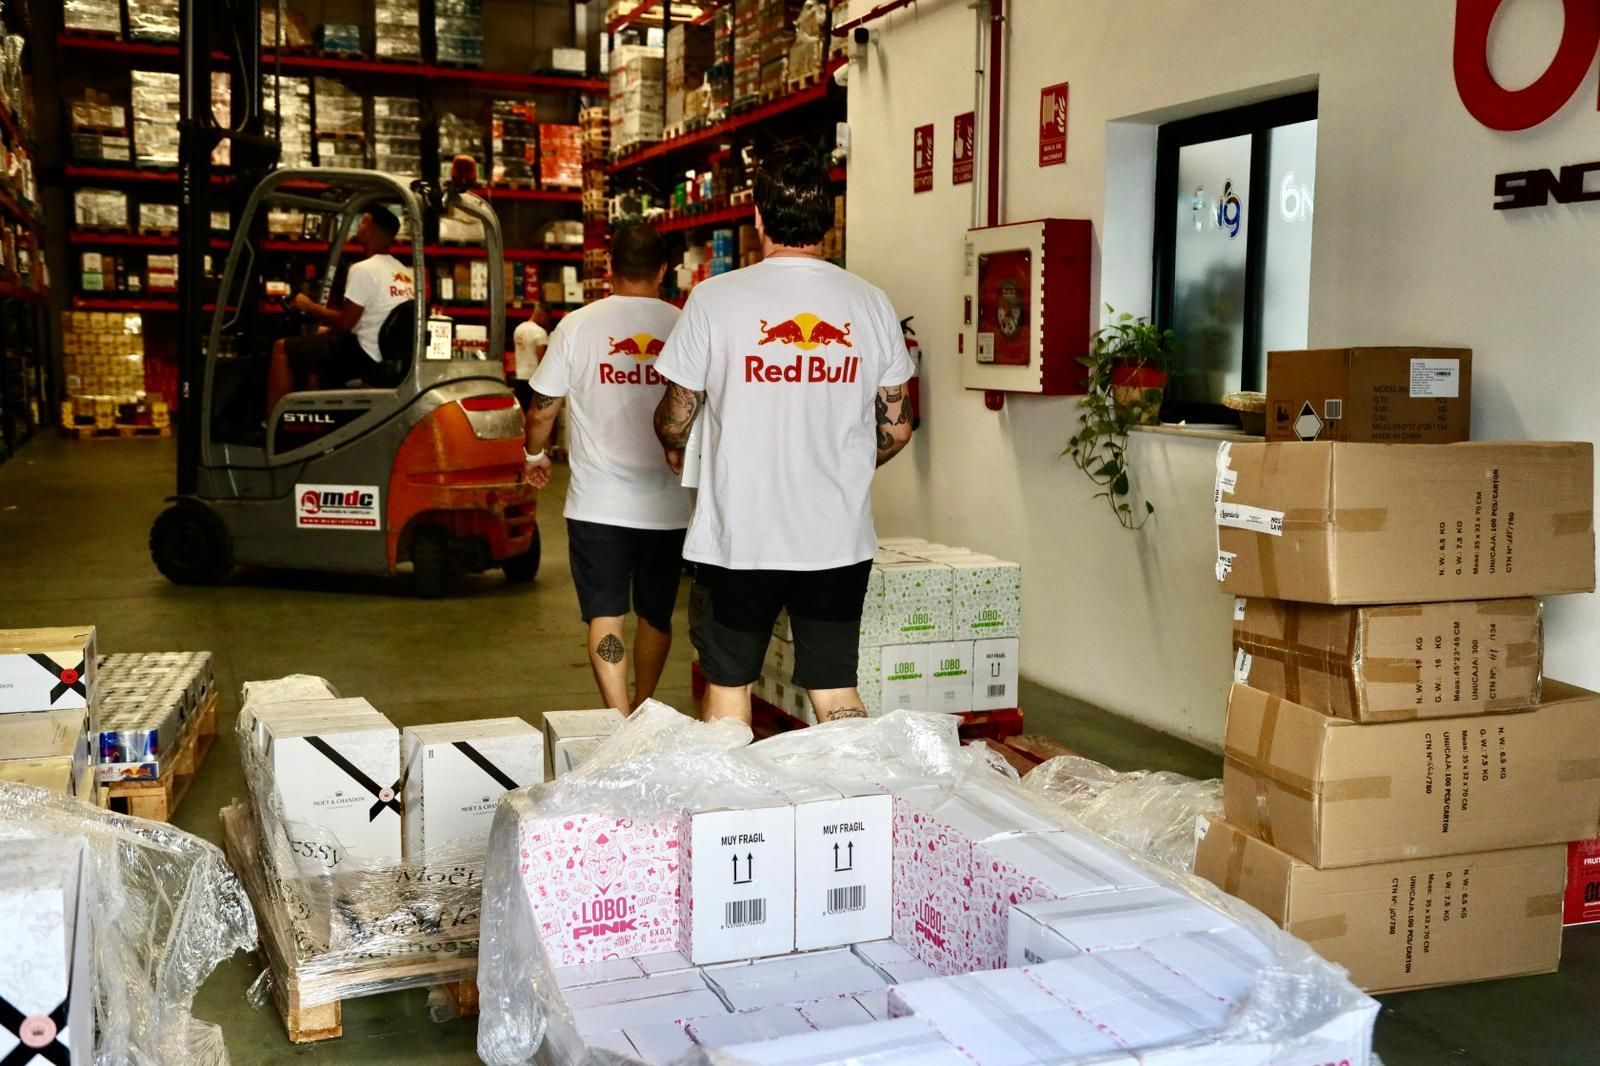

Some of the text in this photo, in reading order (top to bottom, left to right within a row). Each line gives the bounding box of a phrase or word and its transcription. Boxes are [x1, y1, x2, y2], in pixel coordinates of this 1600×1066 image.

[600, 364, 641, 384] Red
[745, 356, 859, 383] Red Bull
[284, 413, 335, 422] STILL
[322, 490, 374, 506] mdc
[1476, 492, 1482, 504] CM
[1475, 506, 1481, 515] 70
[1440, 522, 1445, 534] KG
[1457, 521, 1462, 533] KG
[1475, 523, 1480, 532] 32
[1475, 541, 1480, 550] 35
[908, 613, 928, 624] LOBO
[978, 610, 998, 622] LOBO
[1453, 621, 1460, 635] CM
[1416, 637, 1423, 650] KG
[1435, 636, 1442, 649] KG
[895, 662, 914, 674] LOBO
[940, 659, 960, 670] LOBO
[1416, 659, 1422, 669] 17
[1435, 659, 1441, 668] 18
[1462, 754, 1468, 764] 35
[1463, 772, 1469, 780] 32
[1482, 769, 1488, 781] KG
[1500, 767, 1506, 780] KG
[1462, 789, 1468, 797] 70
[1461, 798, 1468, 811] CM
[823, 822, 865, 835] MUY FRAGIL
[722, 833, 765, 846] MUY FRAGIL
[1426, 899, 1432, 907] 35
[582, 897, 627, 923] LOBO
[920, 899, 941, 933] LOBO
[1443, 910, 1449, 922] KG
[1461, 907, 1467, 919] KG
[1425, 915, 1431, 923] 32
[573, 918, 638, 940] PINK
[1424, 931, 1430, 939] 70
[915, 920, 946, 952] PINK
[1423, 941, 1429, 953] CM
